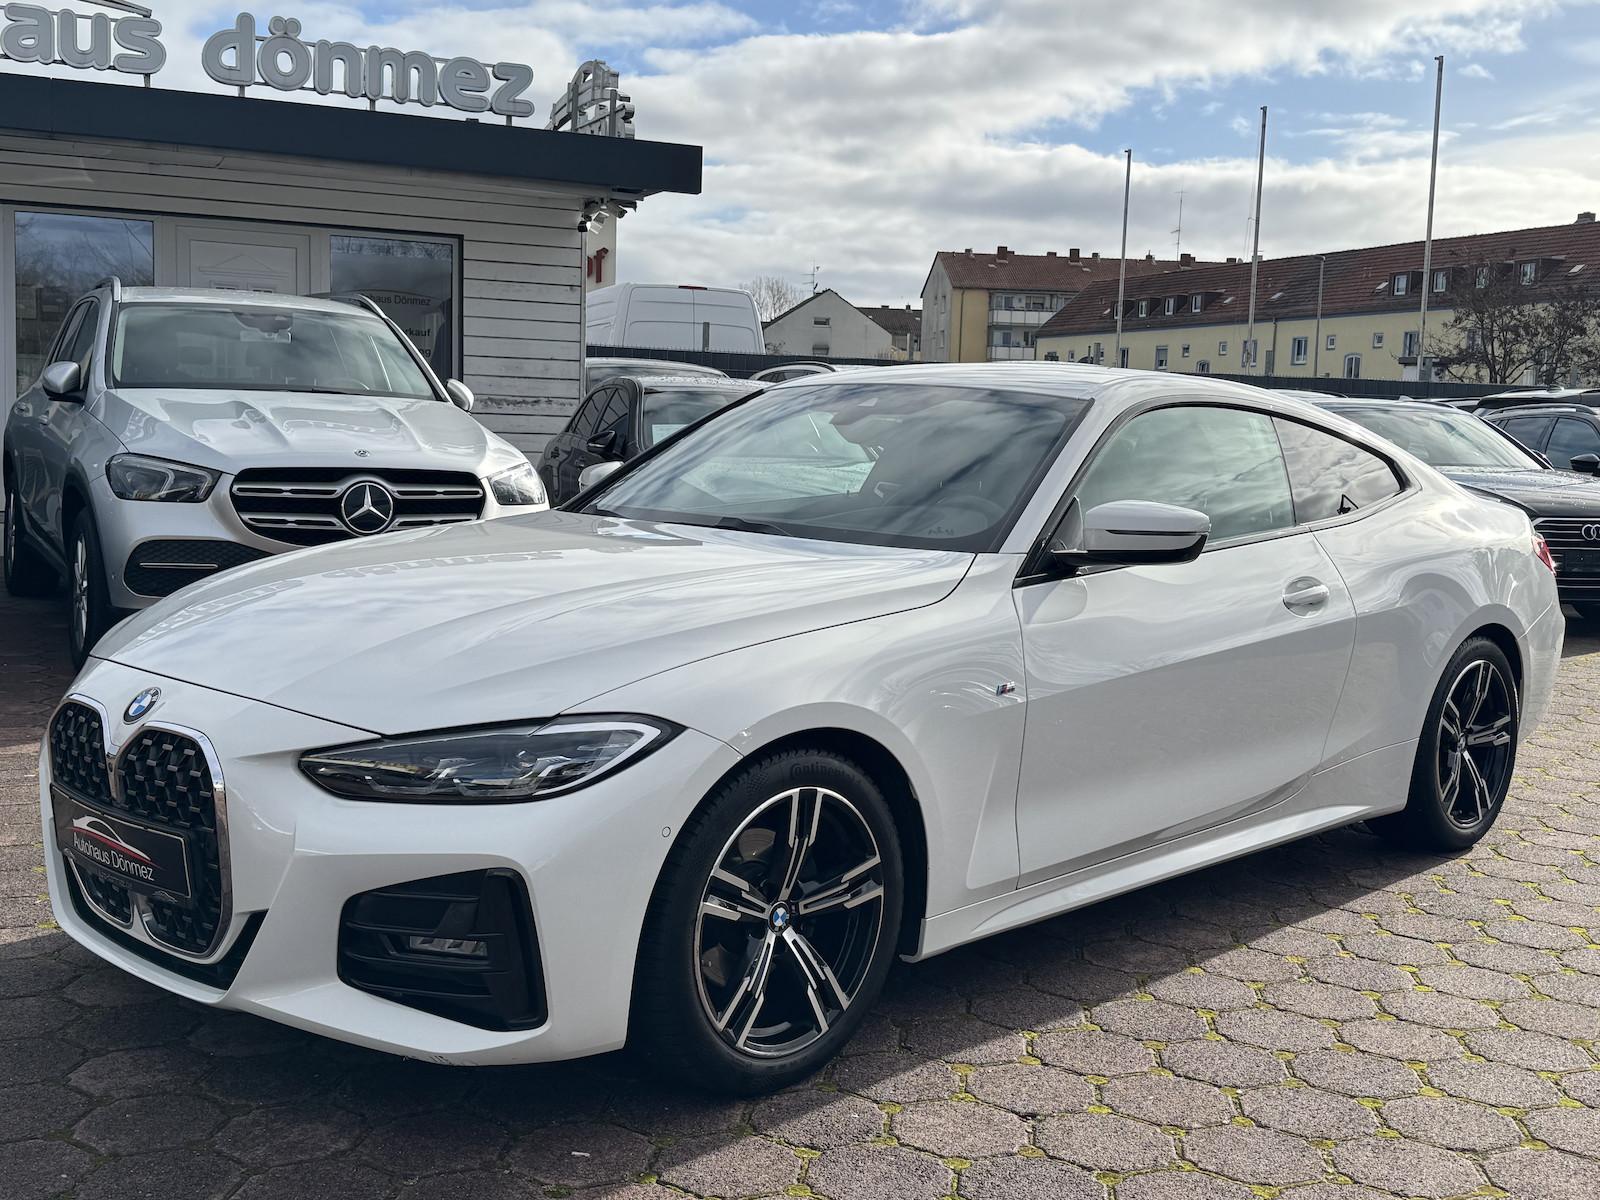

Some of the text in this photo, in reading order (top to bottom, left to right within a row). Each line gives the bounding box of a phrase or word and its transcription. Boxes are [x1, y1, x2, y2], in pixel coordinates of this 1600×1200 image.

[1, 2, 534, 117] aus dönmez
[73, 832, 111, 865] Autohaus
[111, 850, 155, 882] Dönmez
